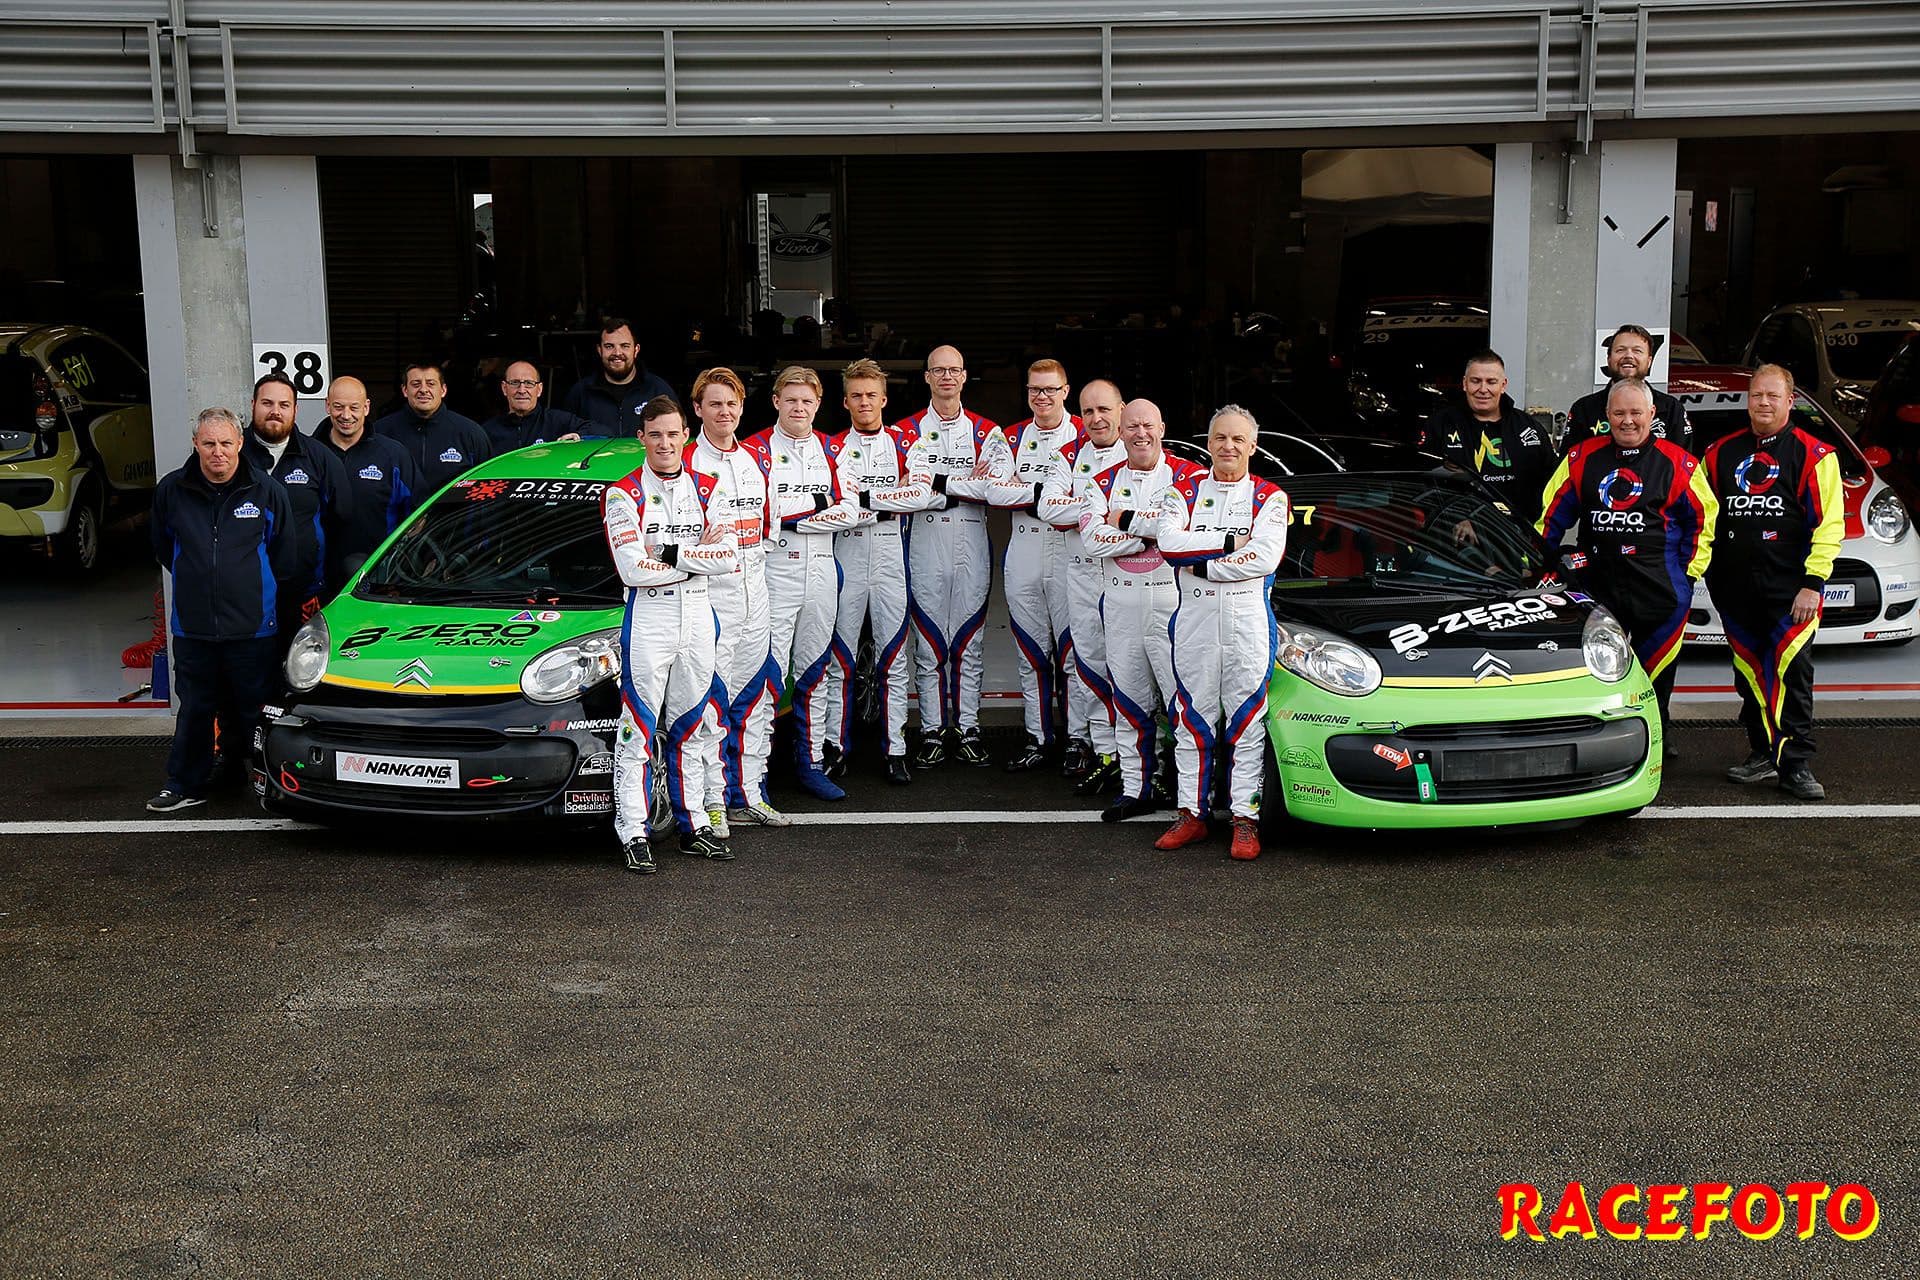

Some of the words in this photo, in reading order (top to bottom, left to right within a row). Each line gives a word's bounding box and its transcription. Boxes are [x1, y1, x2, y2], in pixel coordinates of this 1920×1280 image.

[775, 238, 817, 254] Ford
[1827, 334, 1857, 346] 630
[259, 351, 324, 394] 38
[778, 483, 829, 493] B-ZERO
[876, 490, 920, 501] RACEFOTO
[1726, 496, 1785, 510] TORQ
[1590, 510, 1645, 527] TORQ
[646, 523, 702, 534] B-ZERO
[684, 550, 733, 559] RACEFOTO
[1823, 590, 1849, 600] PORT
[1388, 598, 1547, 654] B-ZERO
[1488, 609, 1557, 631] RACING
[339, 623, 541, 651] B-ZERO
[435, 638, 529, 646] RACING
[1291, 712, 1351, 724] NANKANG
[1382, 748, 1404, 763] TOW
[365, 761, 452, 779] NANKANG
[1293, 784, 1331, 796] Drivlinje
[573, 793, 610, 802] Drivlinje
[1289, 791, 1334, 805] Spesialisten
[566, 803, 613, 812] Spesialisten
